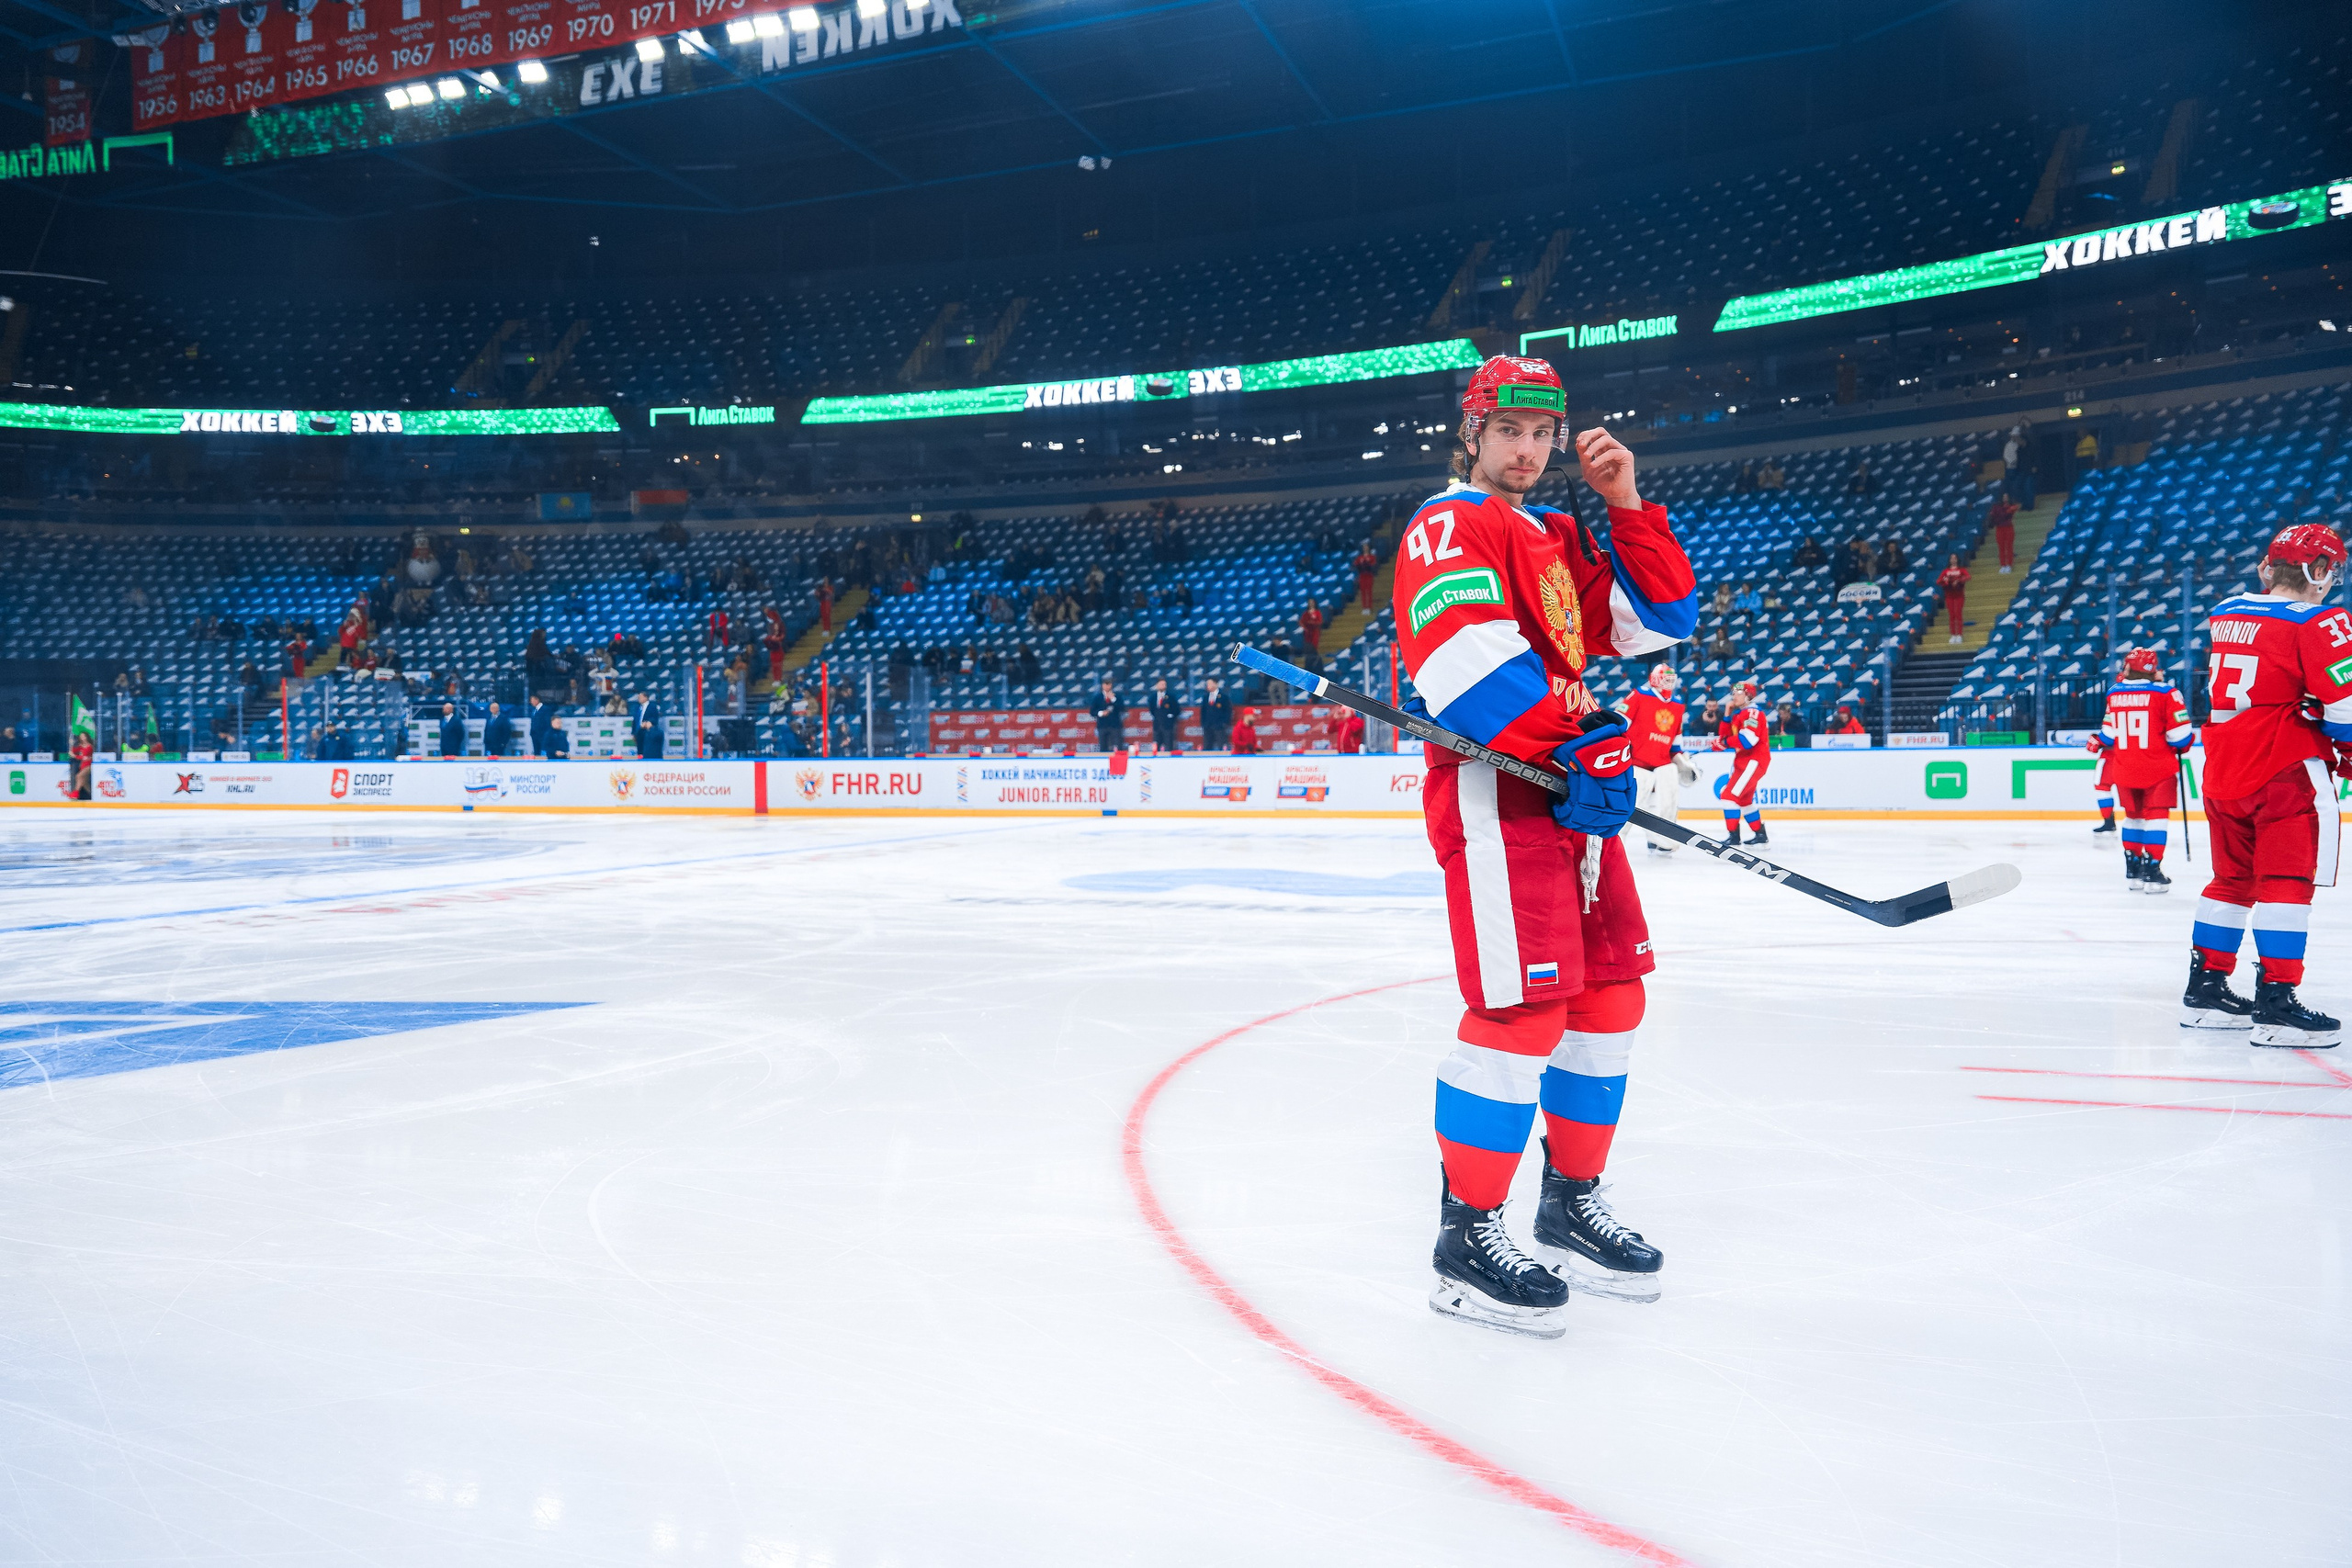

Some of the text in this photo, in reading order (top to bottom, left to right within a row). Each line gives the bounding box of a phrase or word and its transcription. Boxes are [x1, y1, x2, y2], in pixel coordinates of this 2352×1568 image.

[630, 1, 675, 30] 1971
[508, 24, 553, 51] 1969
[567, 14, 615, 42] 1970
[390, 43, 435, 70] 1967
[447, 33, 493, 59] 1968
[285, 64, 328, 90] 1965
[335, 54, 379, 80] 1966
[189, 85, 226, 110] 1963
[235, 75, 276, 101] 1964
[139, 100, 178, 120] 1956
[49, 112, 86, 135] 1954
[2041, 187, 2227, 274] ХОККЕЙ
[1578, 315, 1678, 348] ЛИГА СТАВОК
[1023, 375, 1135, 408] ХОККЕЙ
[1516, 395, 1556, 407] ЛИГА СТАВОК
[180, 410, 298, 433] ХОККЕЙ
[697, 404, 775, 425] ЛИГА СТАВОК
[1407, 509, 1464, 567] 92
[1418, 588, 1492, 625] ЛИГА СТАВОК
[1906, 736, 1945, 744] FHR.RU
[2110, 710, 2150, 750] 49
[1683, 739, 1712, 747] FHR.R
[981, 766, 1020, 780] ХОККЕЙ
[1023, 769, 1088, 780] НАЧИНАЕТСЯ
[1452, 739, 1555, 788] RIBCOR
[354, 773, 394, 785] СПОРТ
[510, 774, 557, 784] МИНСПОРТ
[516, 784, 551, 794] РОССИИ
[644, 773, 706, 783] ФЕДЕРАЦИЯ
[832, 773, 922, 795] FHR.RU
[353, 787, 392, 796] ЭКСПРЕСС
[644, 786, 731, 795] ХОККЕЯ РОССИИ
[999, 787, 1107, 803] JUNIOR.FHR.RU
[1687, 834, 1791, 884] CCM
[1569, 1231, 1600, 1253] BAUER
[1468, 1258, 1499, 1280] BAUER
